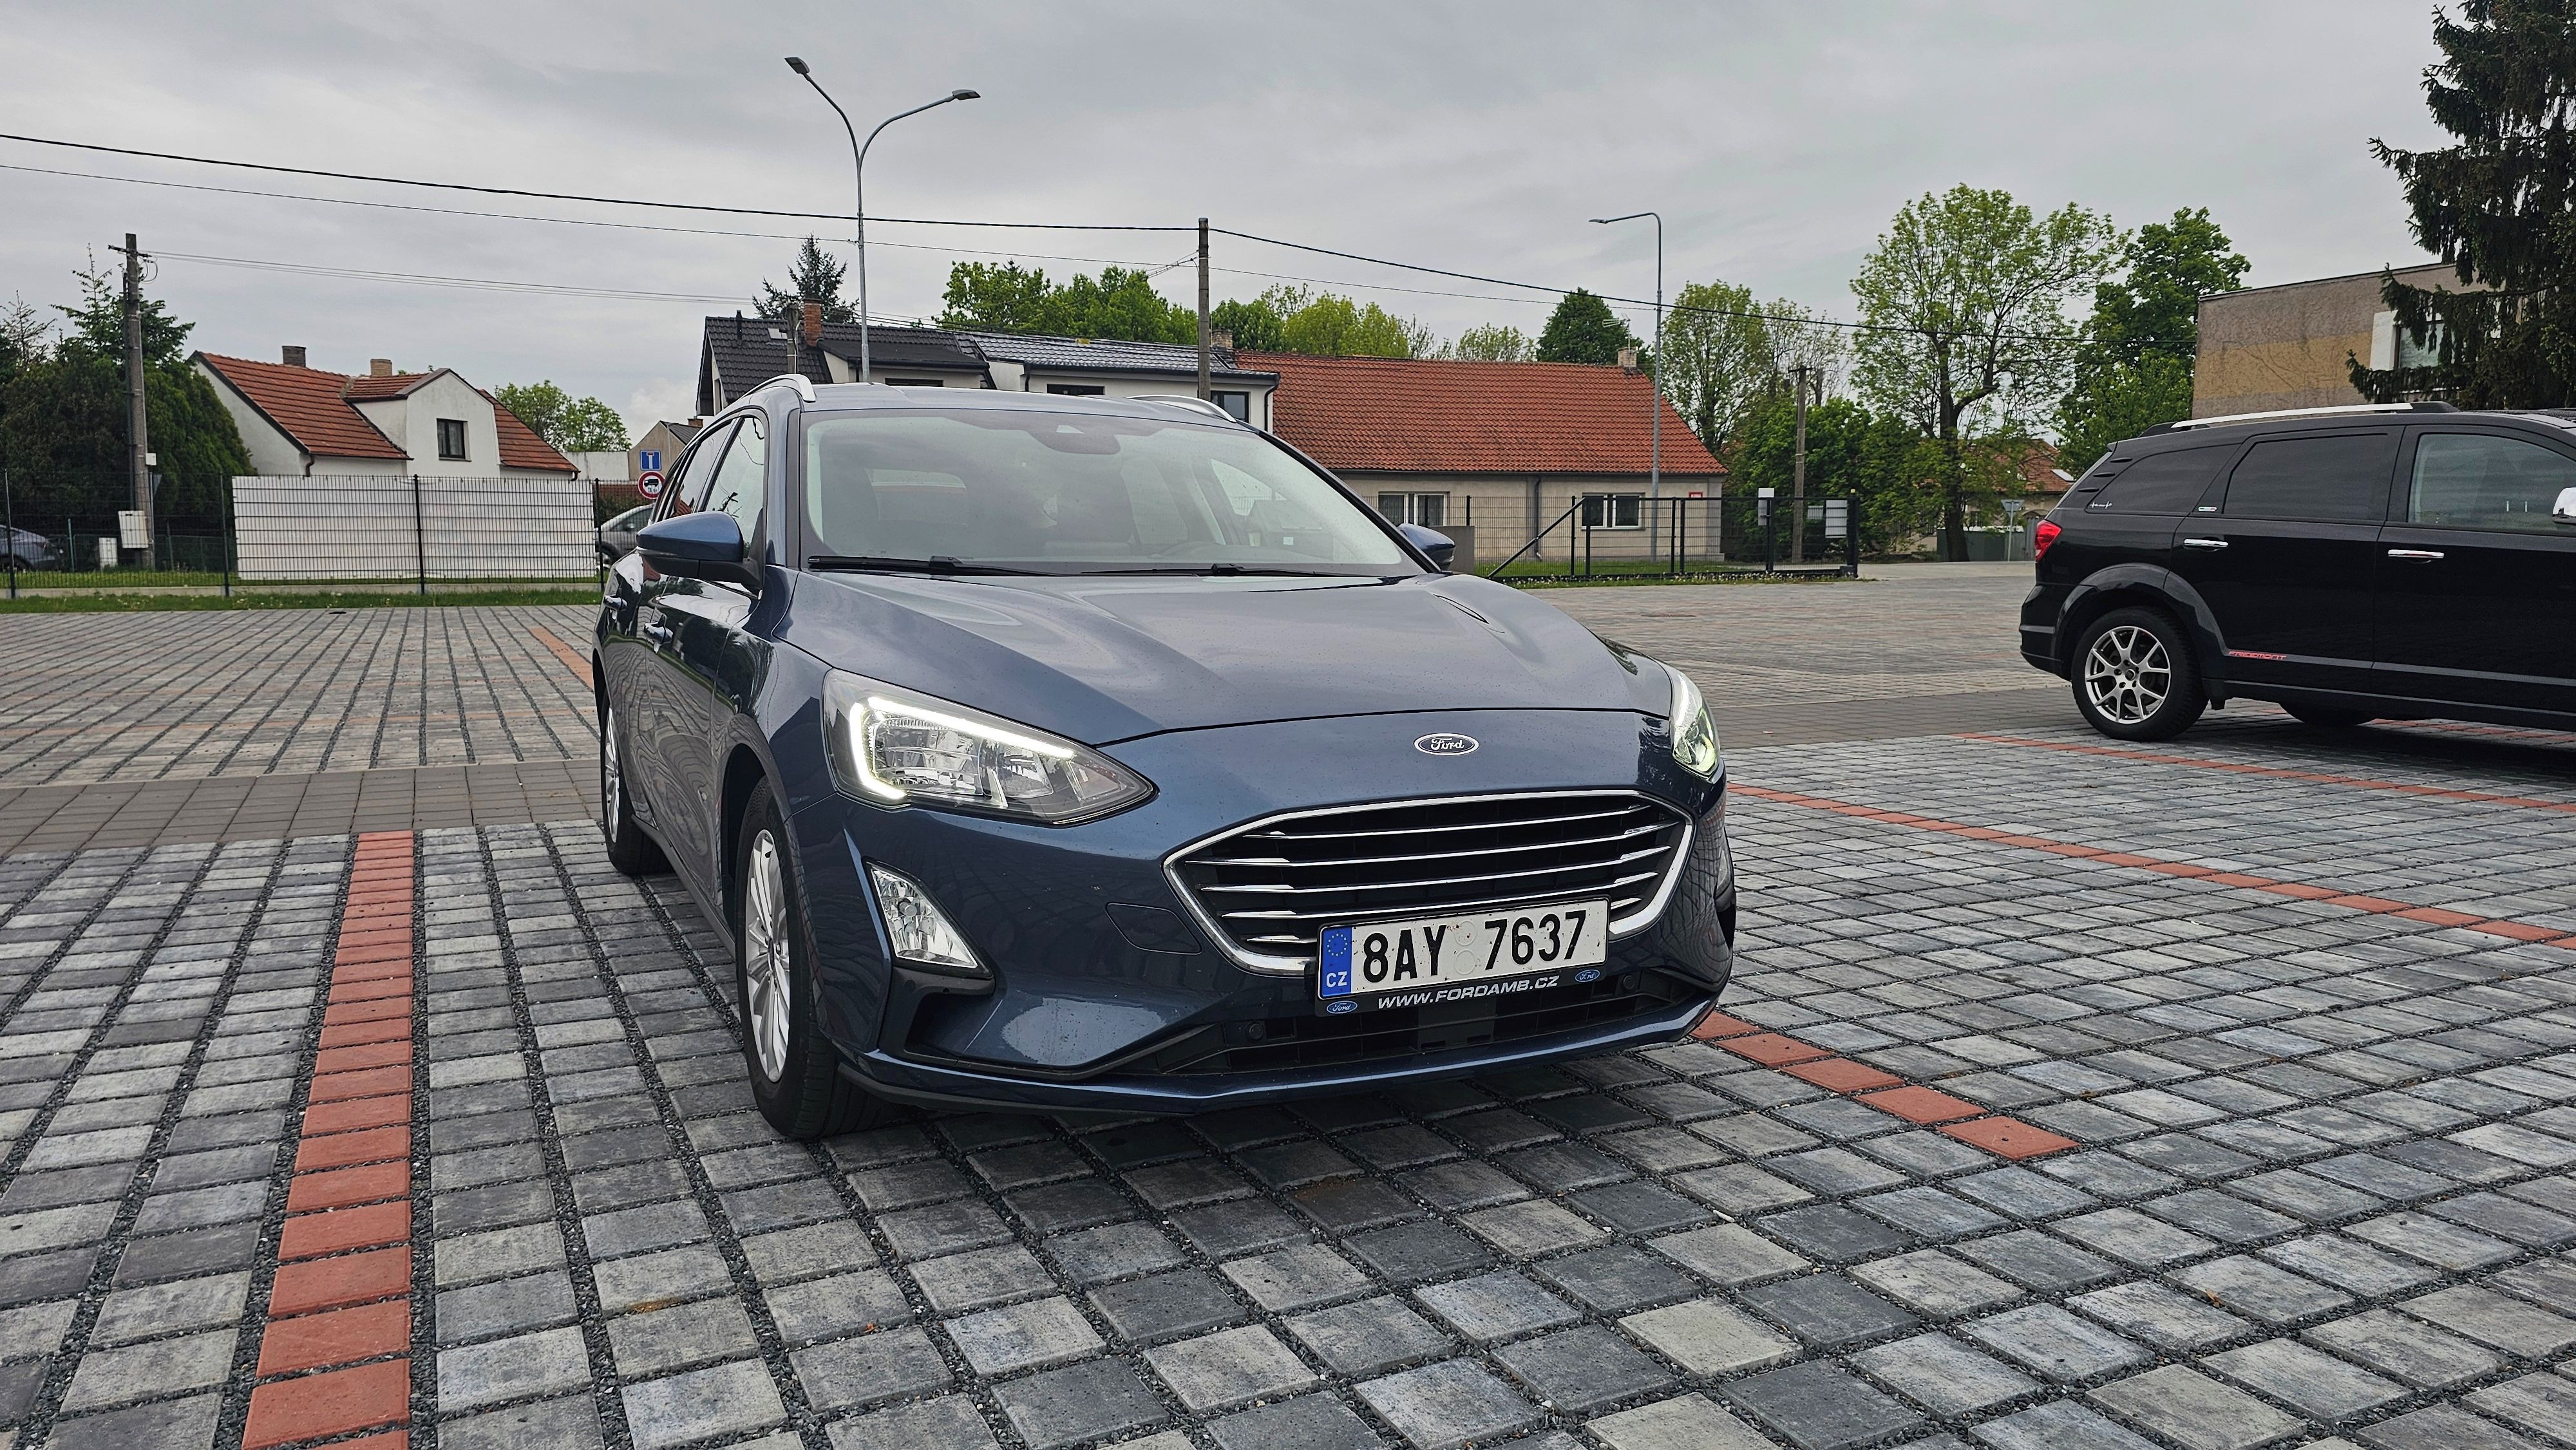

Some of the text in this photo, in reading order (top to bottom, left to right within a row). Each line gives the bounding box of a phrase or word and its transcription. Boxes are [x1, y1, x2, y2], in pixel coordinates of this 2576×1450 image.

[1430, 738, 1465, 751] Ford
[1363, 909, 1586, 983] 8AY 7637
[1326, 971, 1347, 988] CZ
[1378, 975, 1560, 1010] WWW.FORDAMB.CZ
[1332, 1003, 1351, 1012] Ford
